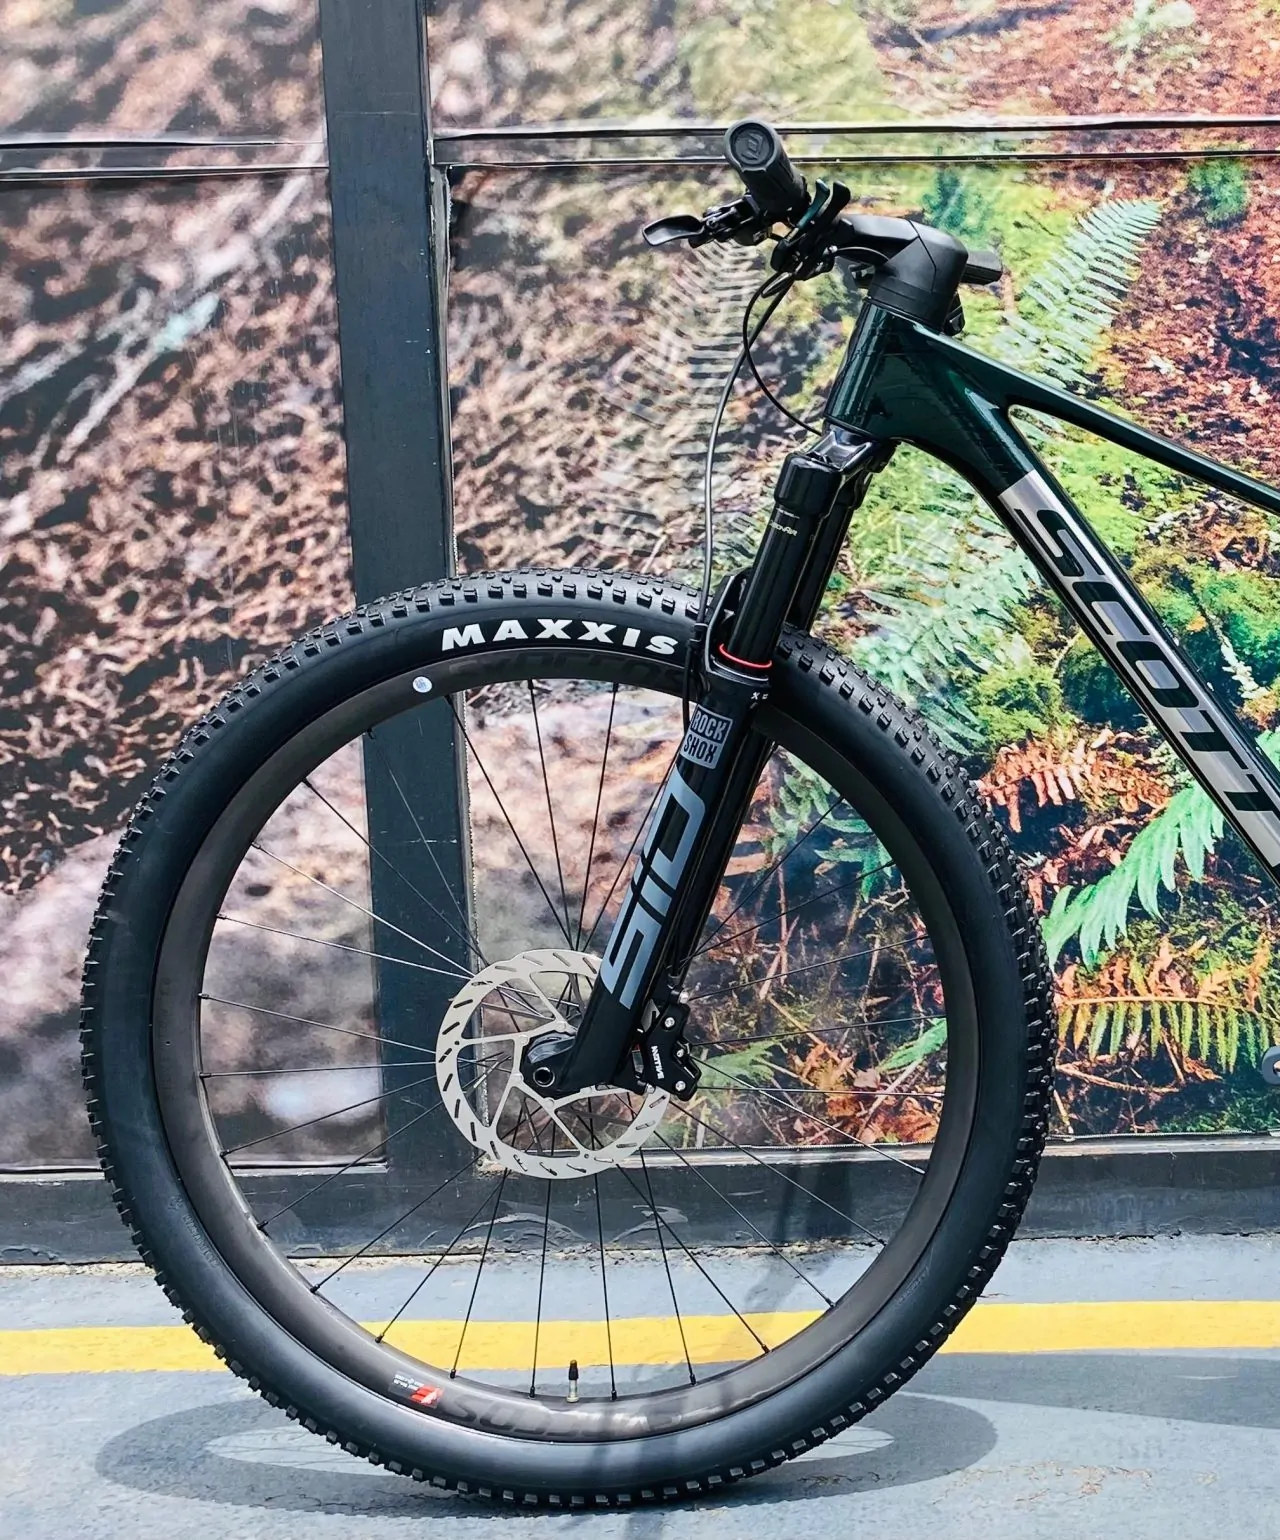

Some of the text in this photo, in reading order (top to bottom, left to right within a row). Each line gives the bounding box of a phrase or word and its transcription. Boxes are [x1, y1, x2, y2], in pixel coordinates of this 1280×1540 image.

[441, 618, 679, 655] MAXXIS
[691, 710, 727, 741] ROCK
[683, 733, 718, 764] SHOX
[600, 767, 706, 1010] SID
